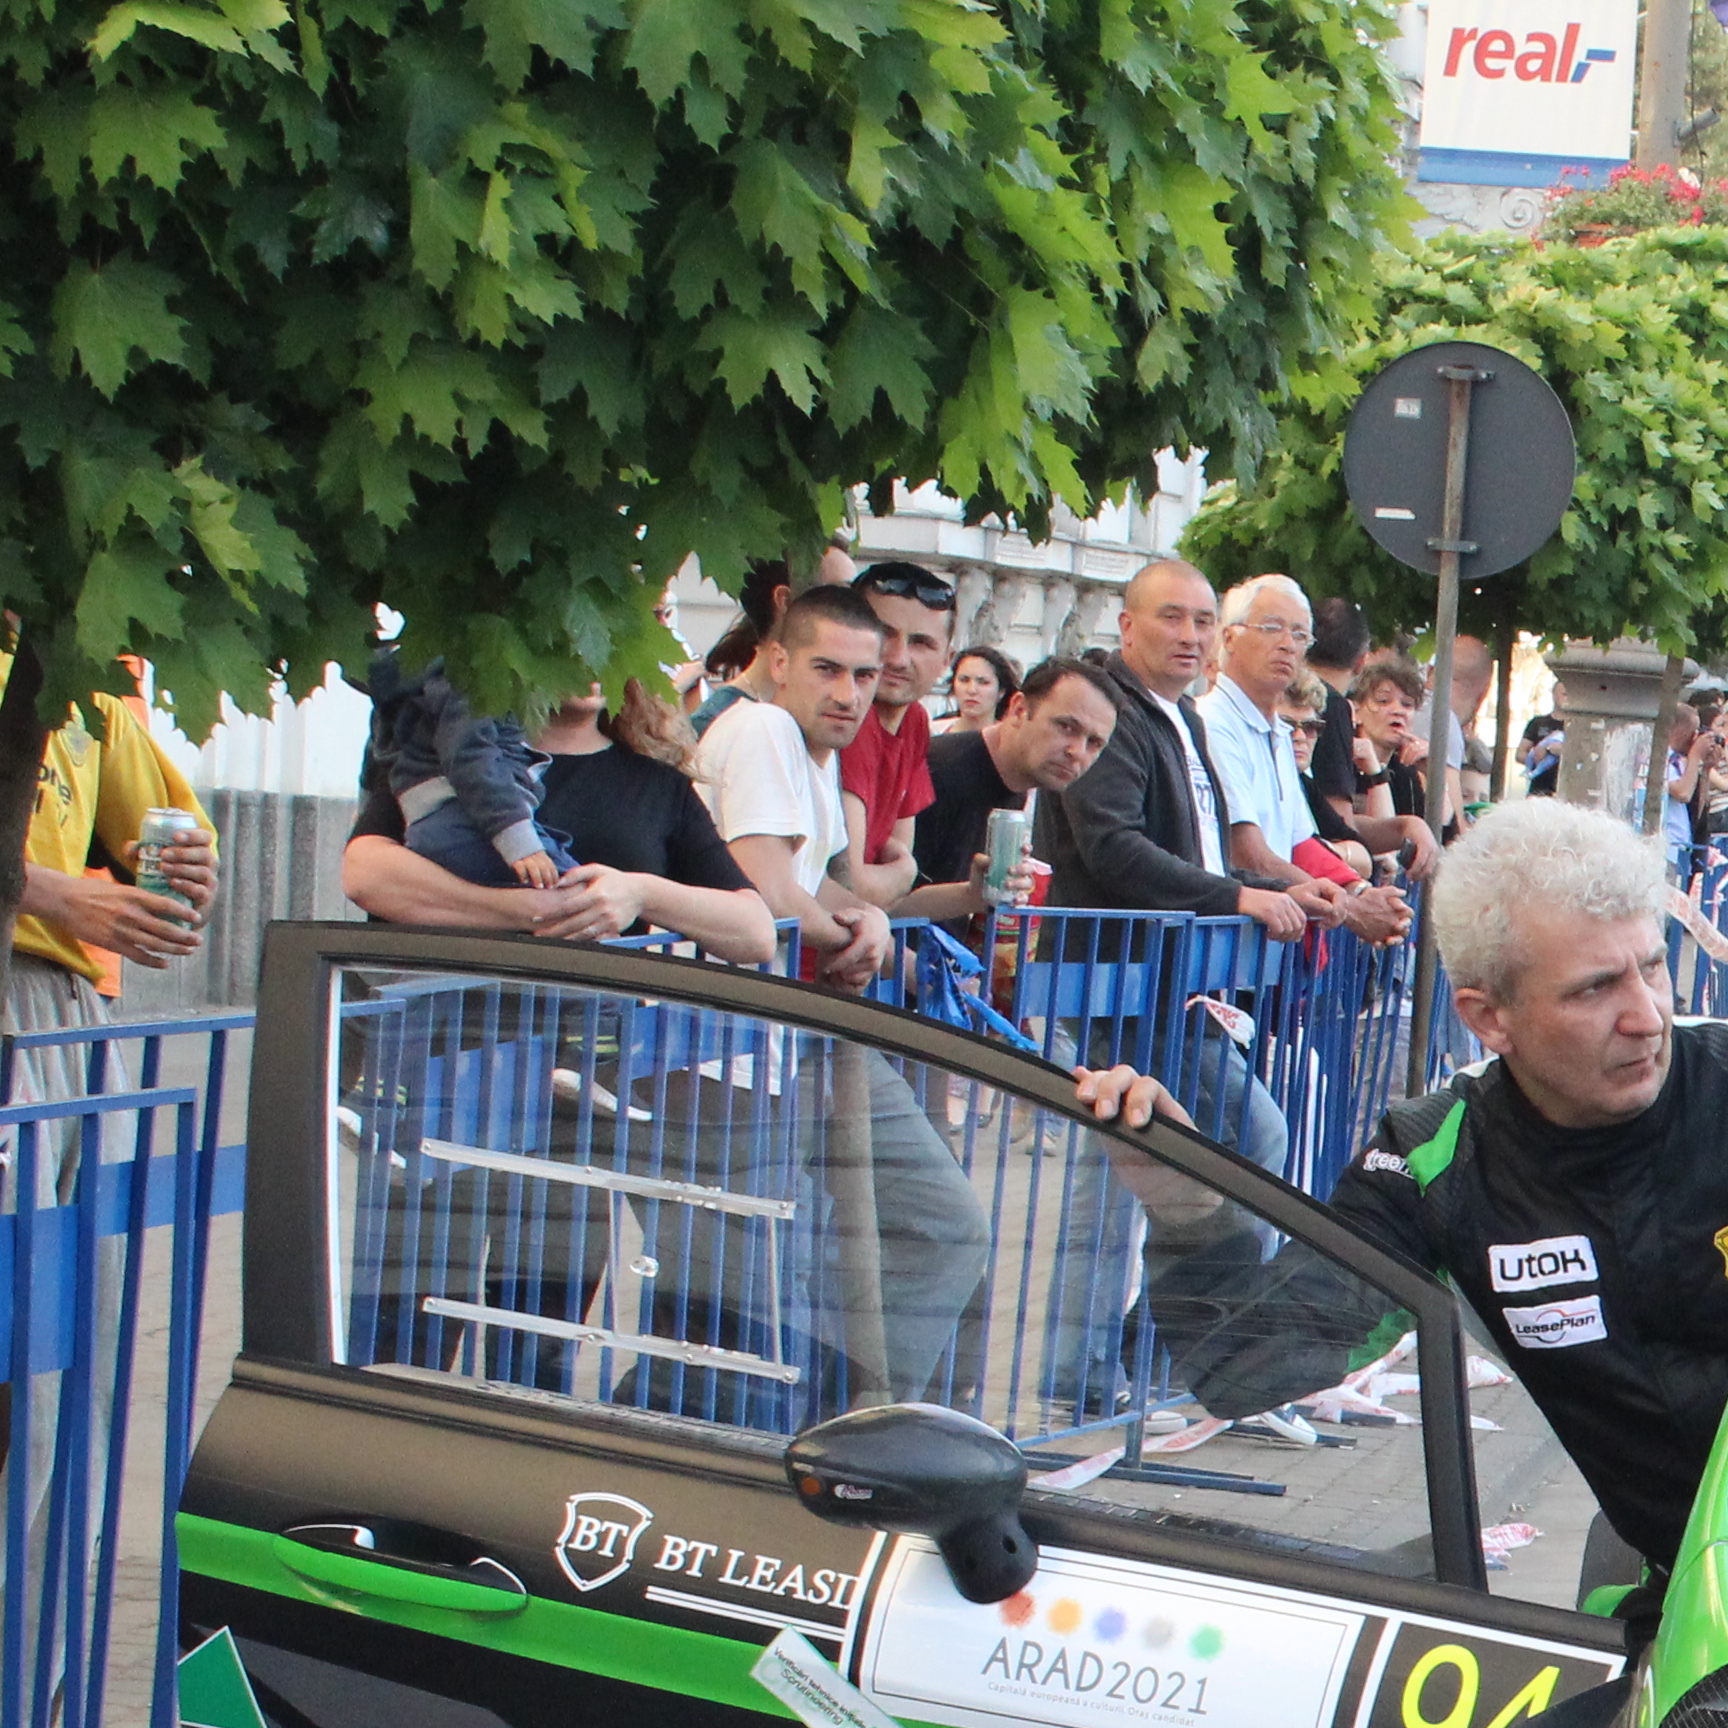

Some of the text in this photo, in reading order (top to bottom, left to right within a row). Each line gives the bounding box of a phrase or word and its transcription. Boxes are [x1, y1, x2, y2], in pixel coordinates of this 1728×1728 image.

[1515, 1312, 1595, 1336] LeasePlan
[567, 1514, 630, 1558] BT
[653, 1534, 859, 1610] BT LEASI
[981, 1636, 1211, 1716] ARAD2021
